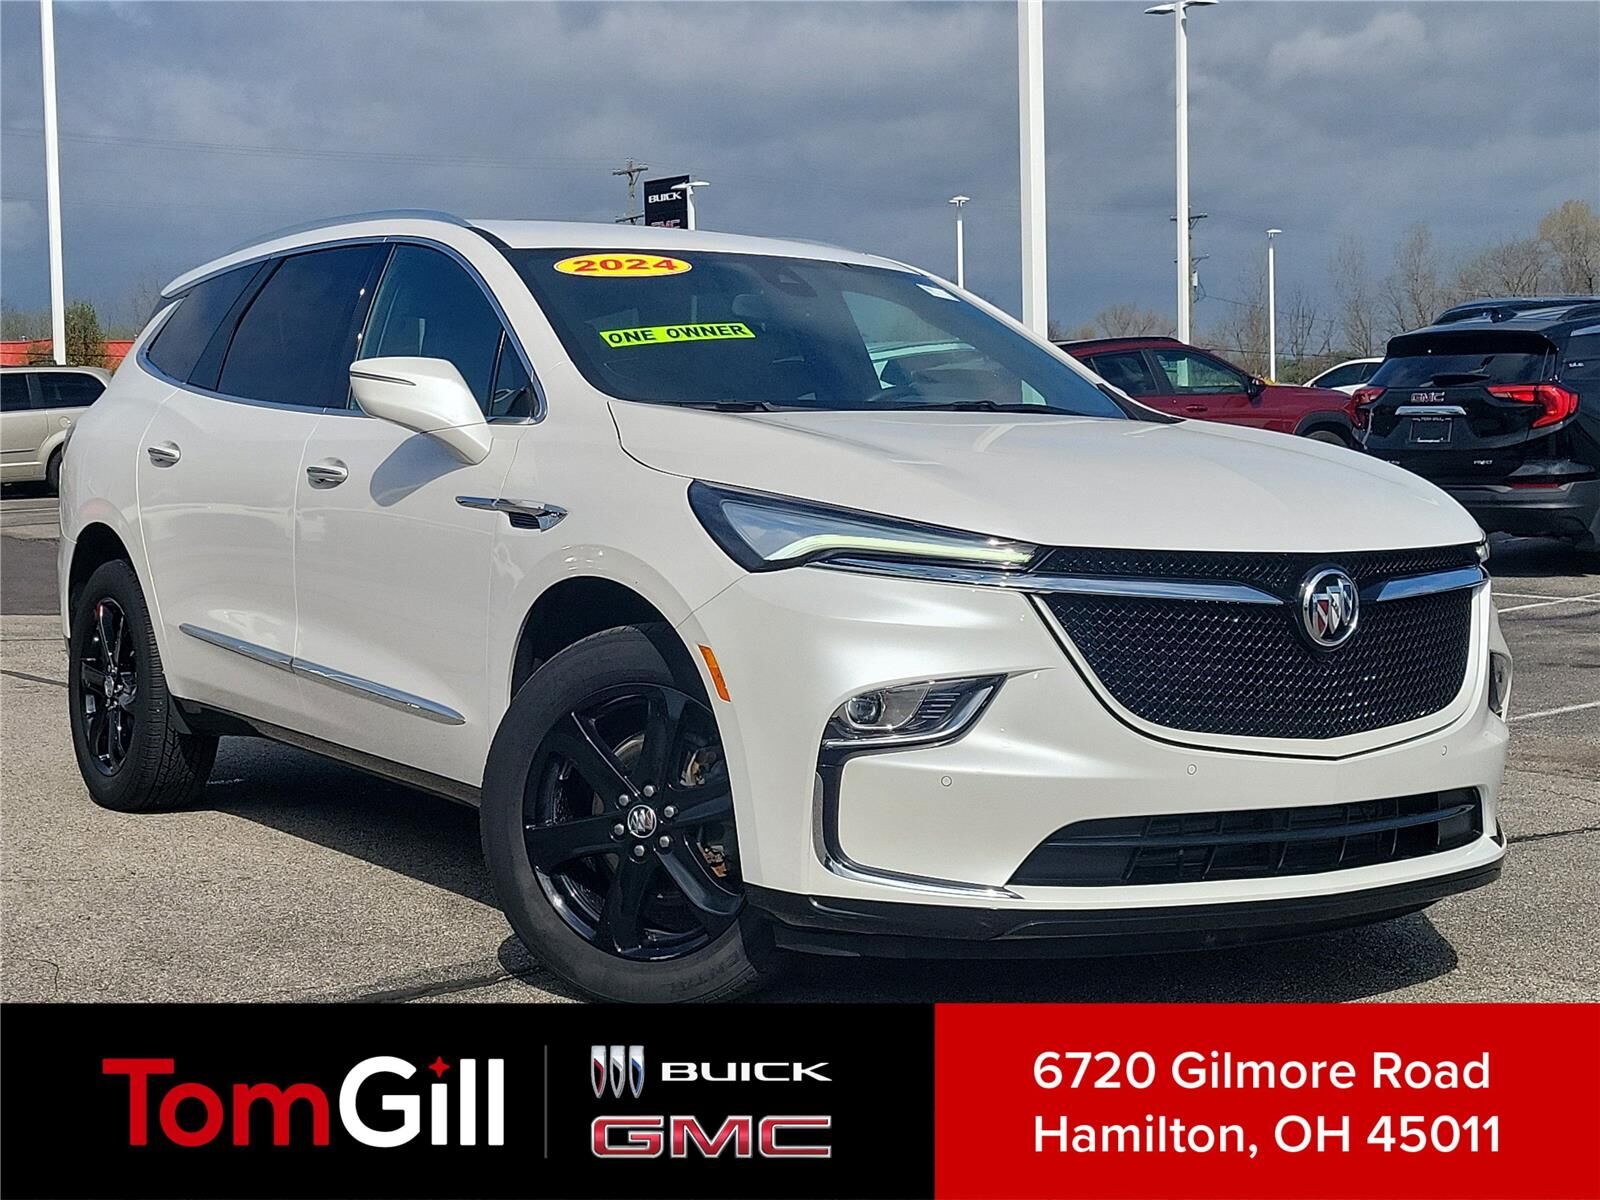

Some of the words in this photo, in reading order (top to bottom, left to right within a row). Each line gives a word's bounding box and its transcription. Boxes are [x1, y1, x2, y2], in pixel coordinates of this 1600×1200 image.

[648, 191, 682, 204] BUICK
[573, 258, 677, 273] 2024
[608, 329, 656, 344] ONE
[666, 325, 747, 339] OWNER
[1411, 392, 1445, 403] GMC
